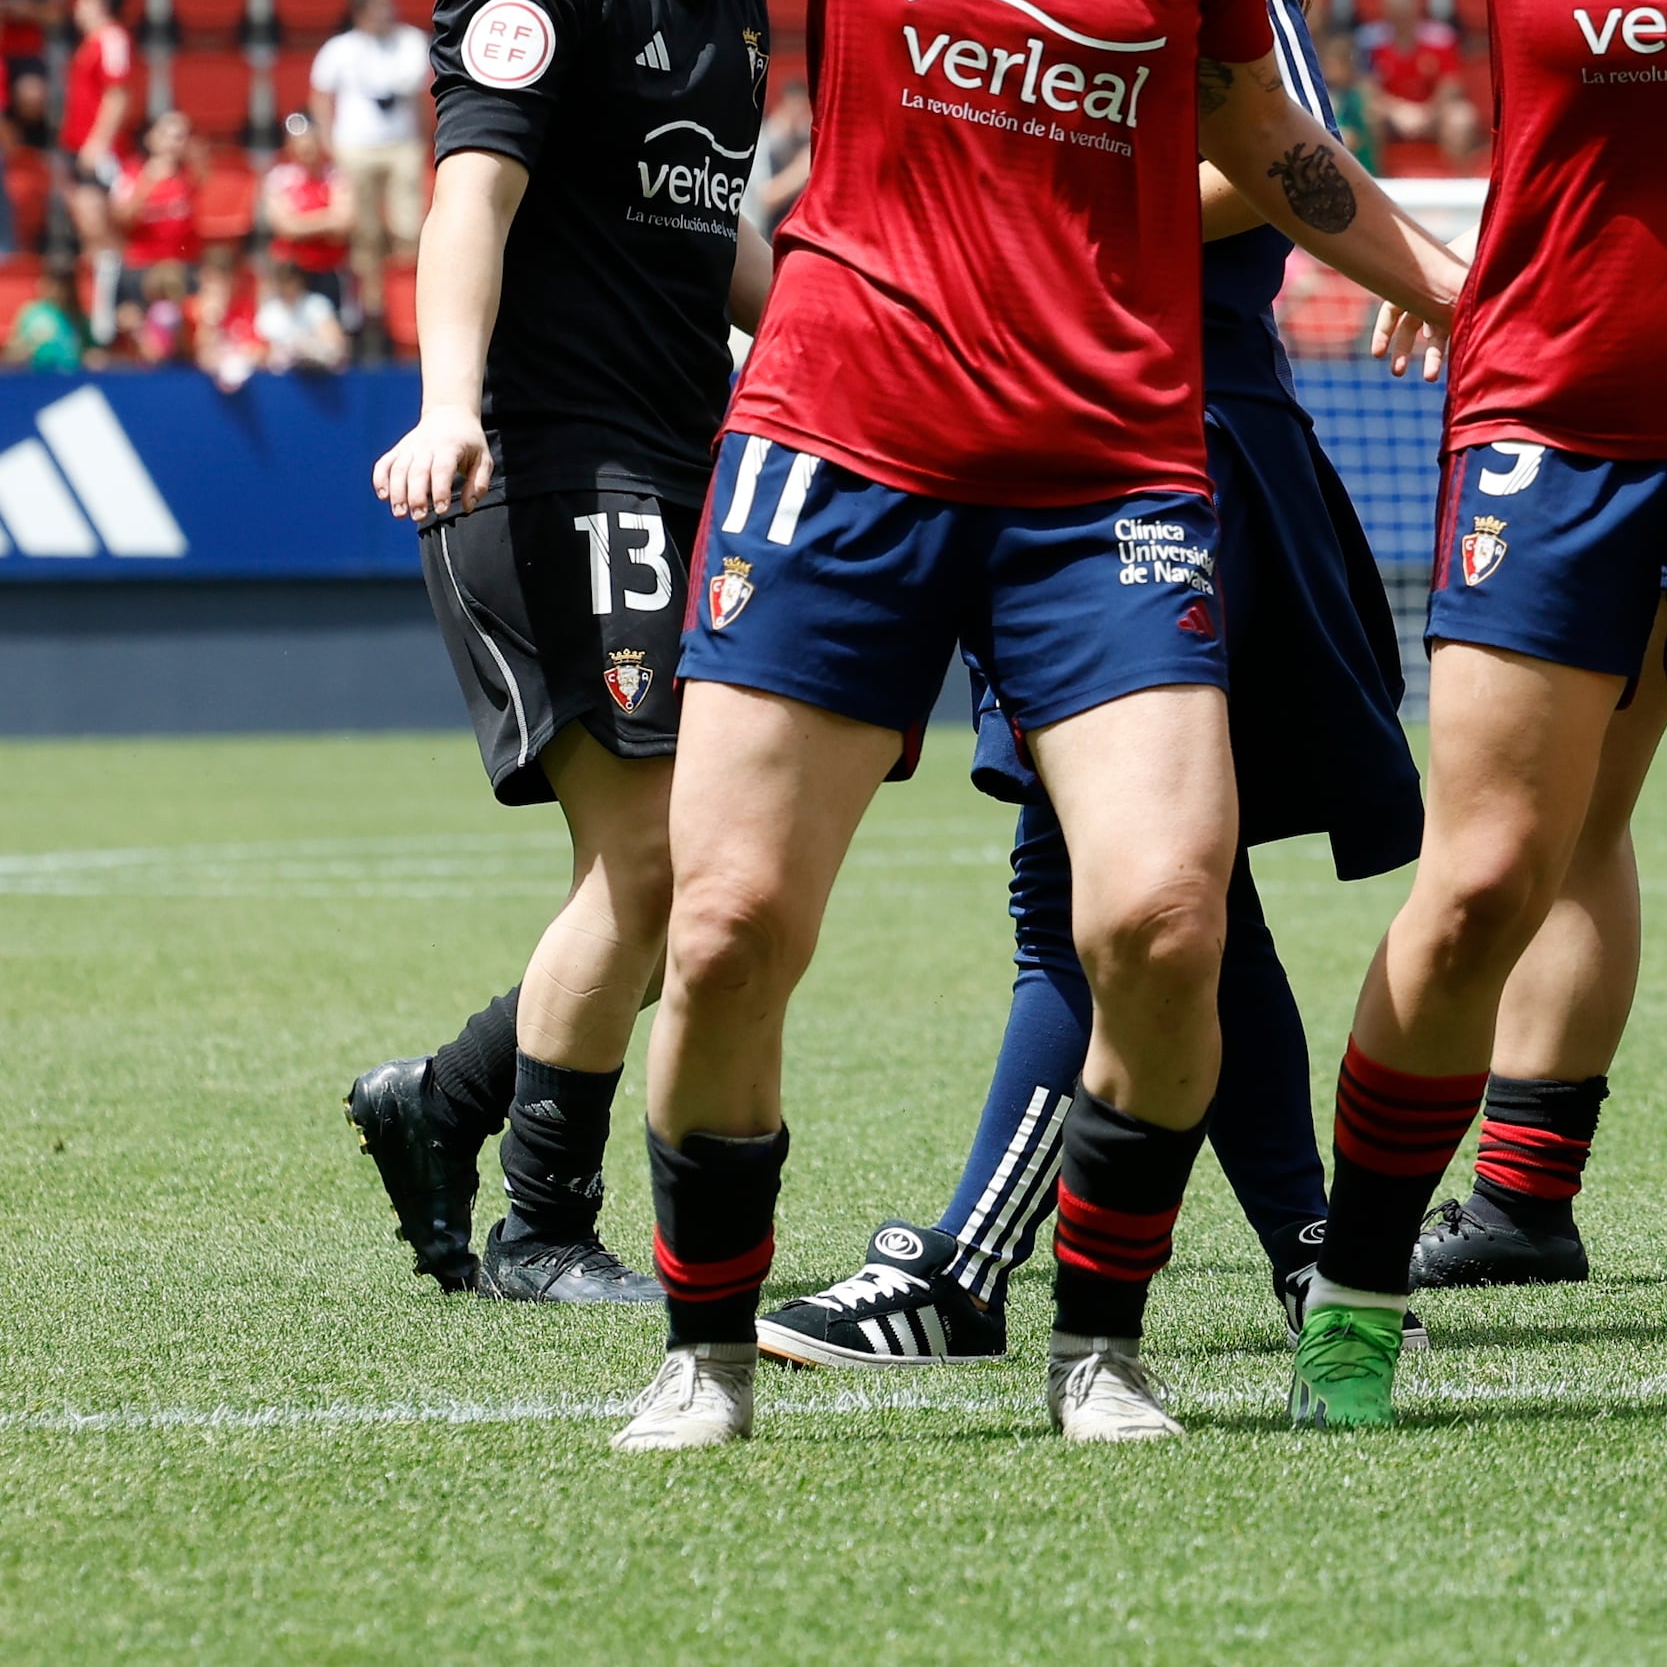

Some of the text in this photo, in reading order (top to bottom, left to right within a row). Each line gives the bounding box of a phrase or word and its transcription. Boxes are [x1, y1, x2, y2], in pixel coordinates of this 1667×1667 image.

[903, 25, 1150, 128] verleal
[1581, 67, 1604, 84] La
[901, 88, 1132, 157] La revolución de la verdura
[637, 155, 747, 216] verlea
[626, 206, 645, 223] La
[648, 213, 710, 234] revolución
[720, 435, 821, 546] 11
[1114, 519, 1185, 542] Clínica
[573, 512, 673, 615] 13
[1119, 563, 1148, 585] de
